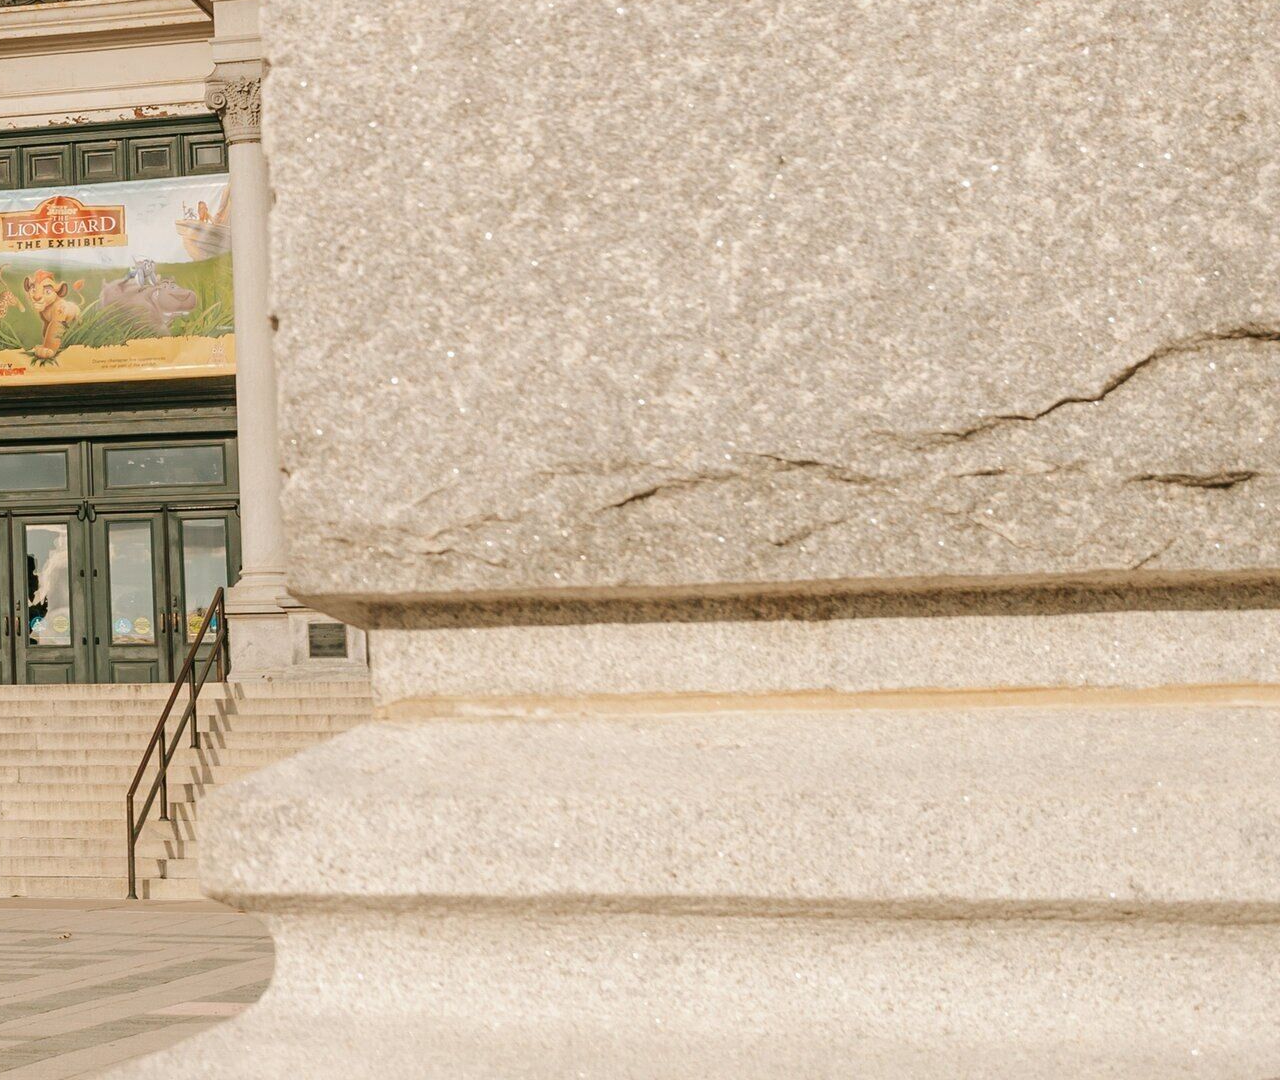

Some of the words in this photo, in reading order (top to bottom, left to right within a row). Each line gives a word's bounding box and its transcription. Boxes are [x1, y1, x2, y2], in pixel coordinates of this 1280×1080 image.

[7, 221, 48, 237] LION
[51, 216, 116, 235] GUARD
[16, 241, 41, 250] THE
[48, 237, 105, 248] EXHIBIT
